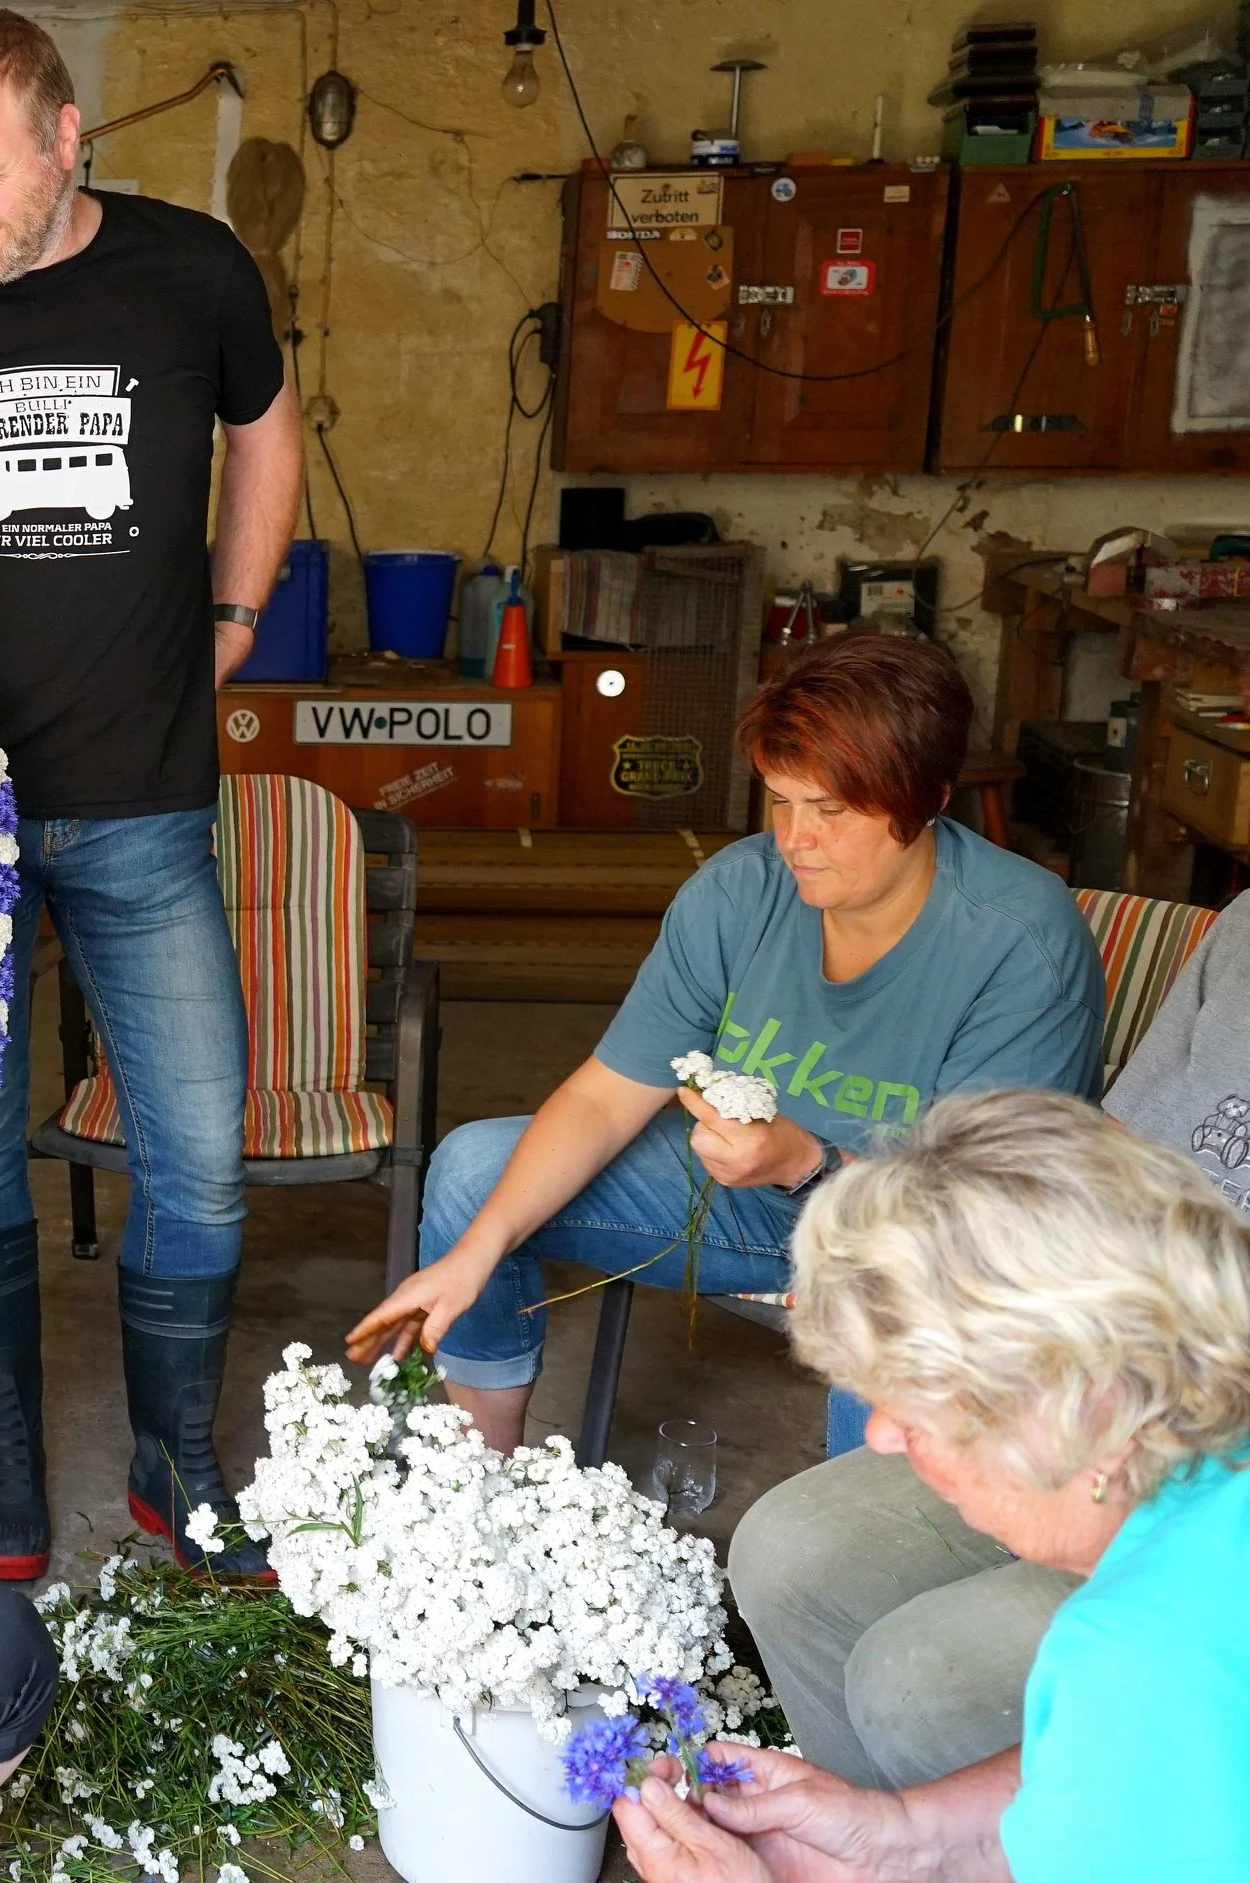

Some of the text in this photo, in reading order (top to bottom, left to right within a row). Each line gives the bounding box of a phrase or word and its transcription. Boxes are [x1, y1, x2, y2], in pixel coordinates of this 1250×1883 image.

[642, 188, 690, 204] Zutritt
[631, 210, 699, 224] verboten
[21, 375, 58, 391] BIN
[65, 375, 101, 389] EIN
[15, 399, 68, 413] BULLI
[79, 412, 124, 436] PAPA
[2, 524, 20, 533] EIN
[22, 524, 82, 533] NORMALER
[84, 522, 112, 532] PAPA
[15, 534, 50, 546] VIEL
[53, 533, 112, 546] COOLER
